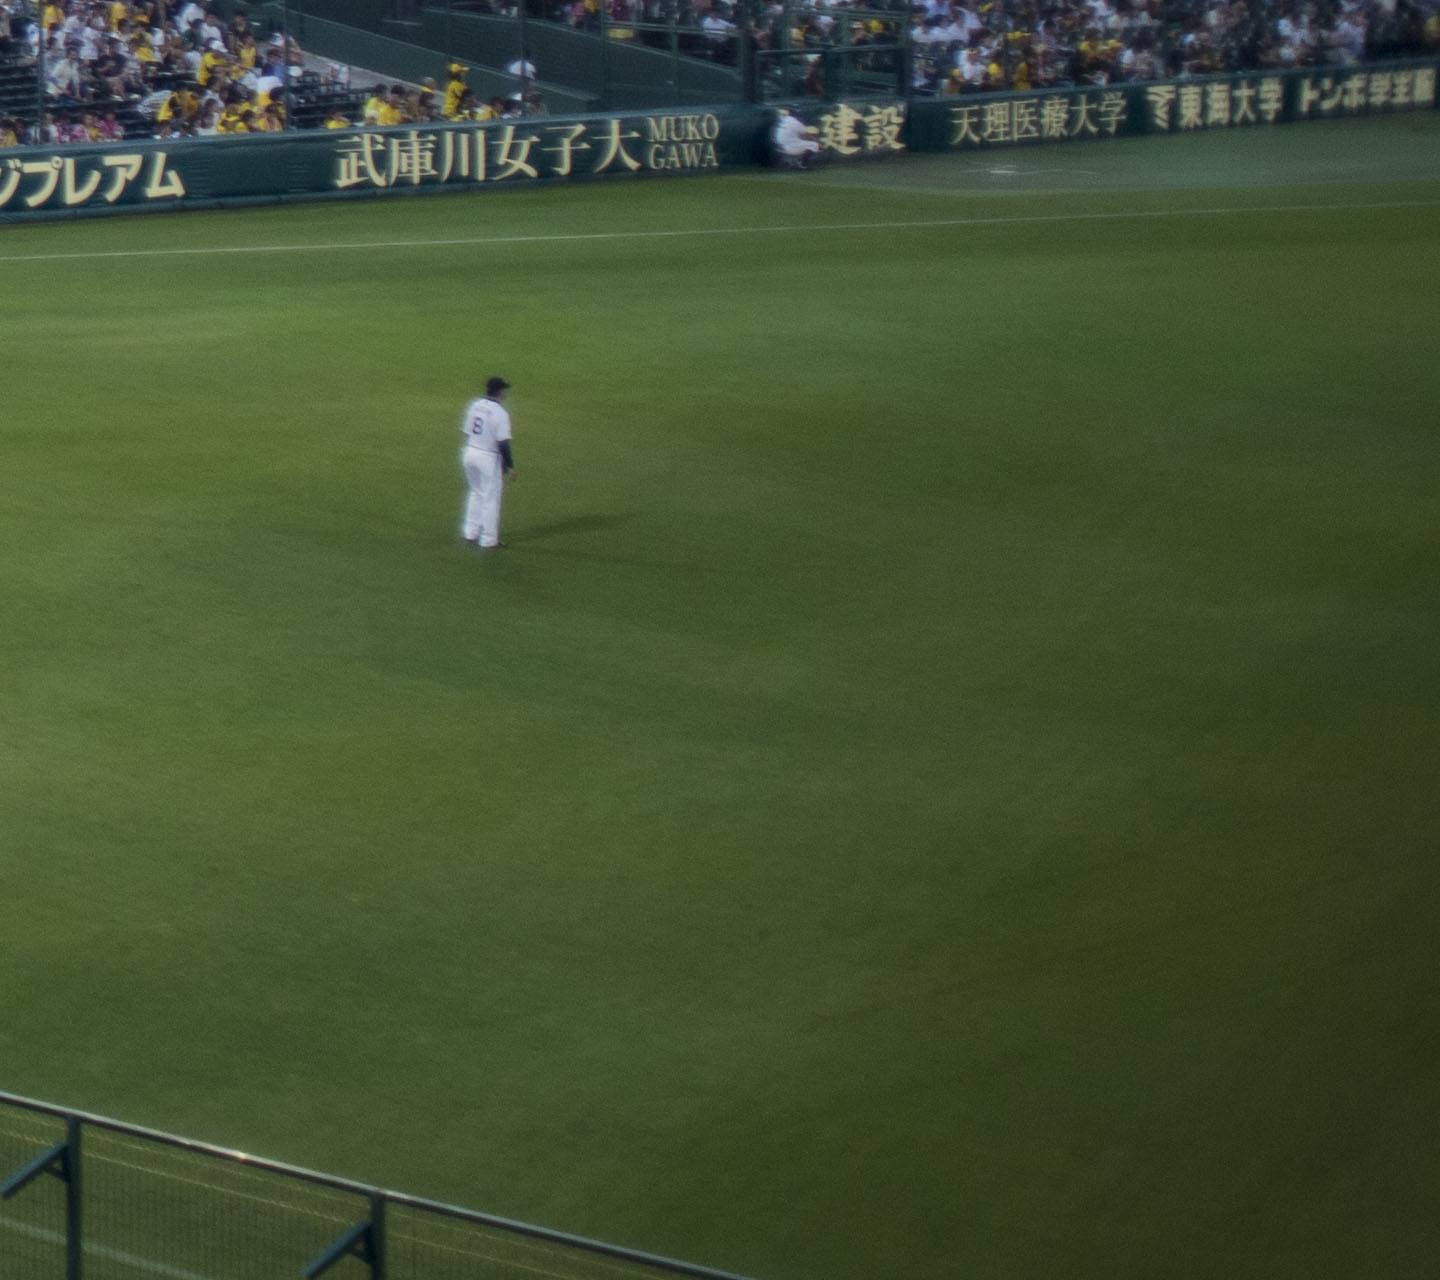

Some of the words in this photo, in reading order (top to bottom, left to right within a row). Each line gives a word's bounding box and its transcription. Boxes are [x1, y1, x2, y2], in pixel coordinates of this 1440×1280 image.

[647, 113, 721, 143] MUKO
[948, 90, 1128, 146] 天理医療大学
[1178, 76, 1284, 130] 東海大学
[334, 119, 642, 190] 武庫川女子大
[648, 142, 721, 171] GAWA
